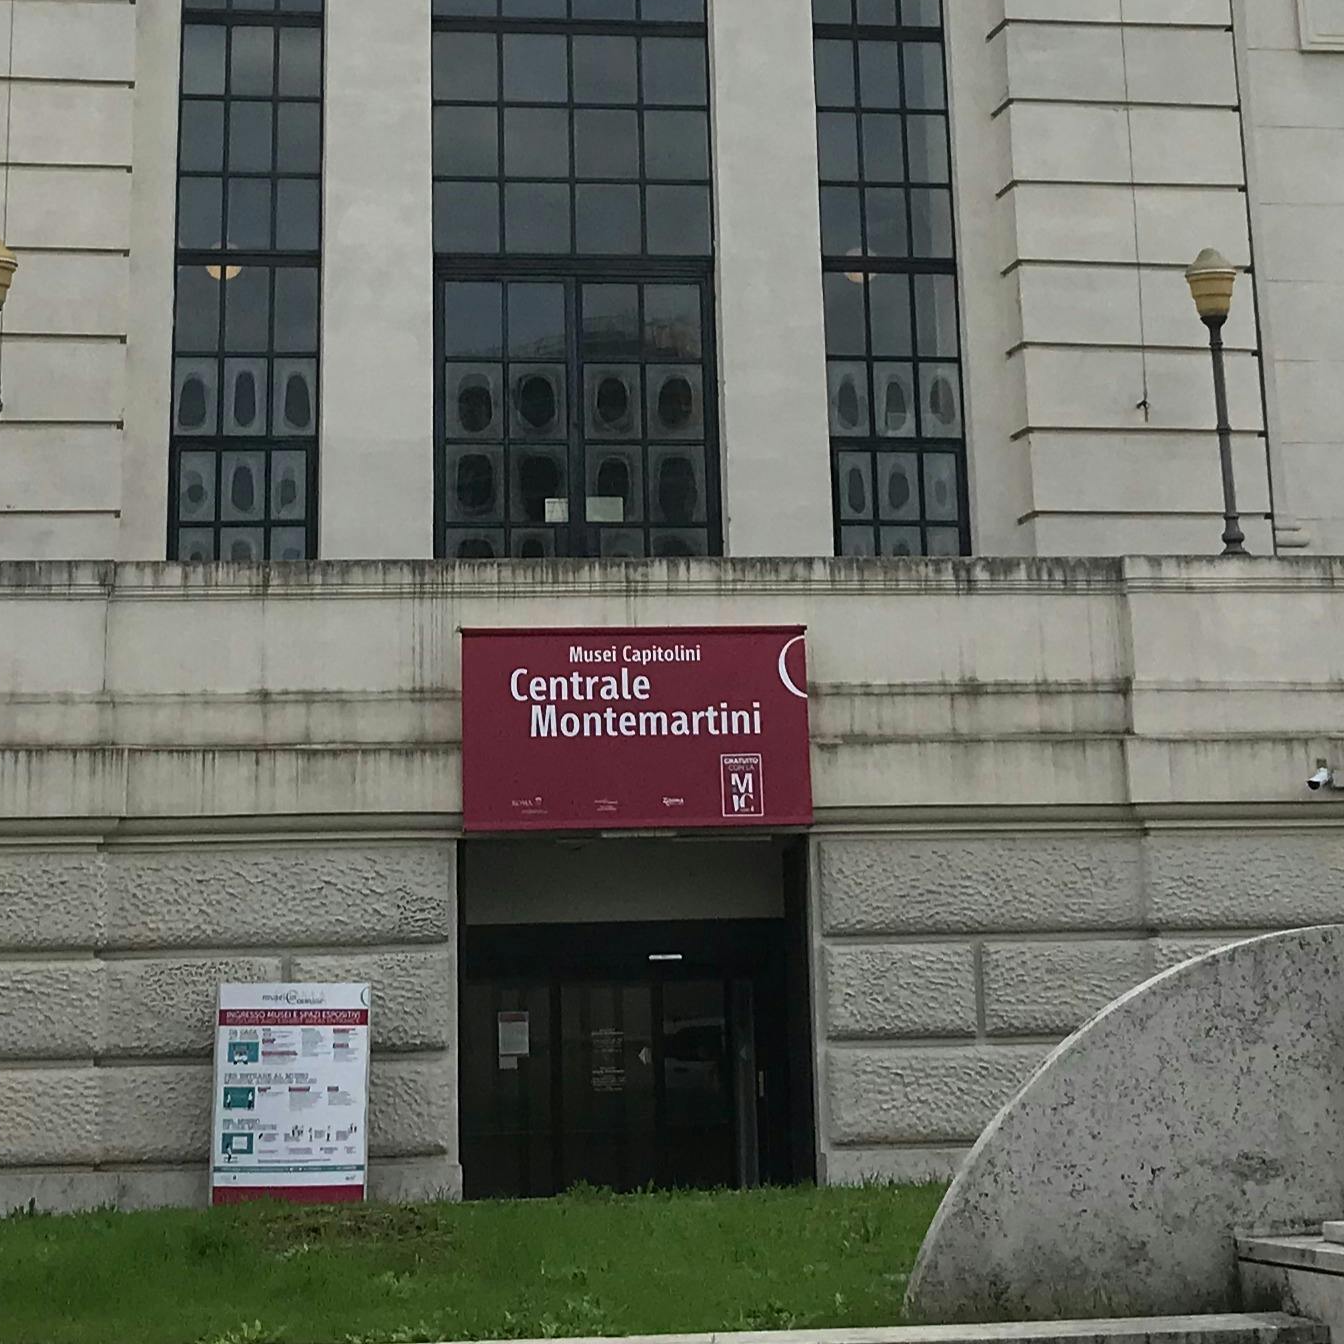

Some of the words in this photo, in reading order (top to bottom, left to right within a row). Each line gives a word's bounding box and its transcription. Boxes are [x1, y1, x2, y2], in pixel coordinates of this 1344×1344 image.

[569, 645, 617, 664] Musei
[623, 644, 701, 666] Capitolini
[511, 668, 651, 702] Centrale
[530, 702, 762, 737] Montemartini
